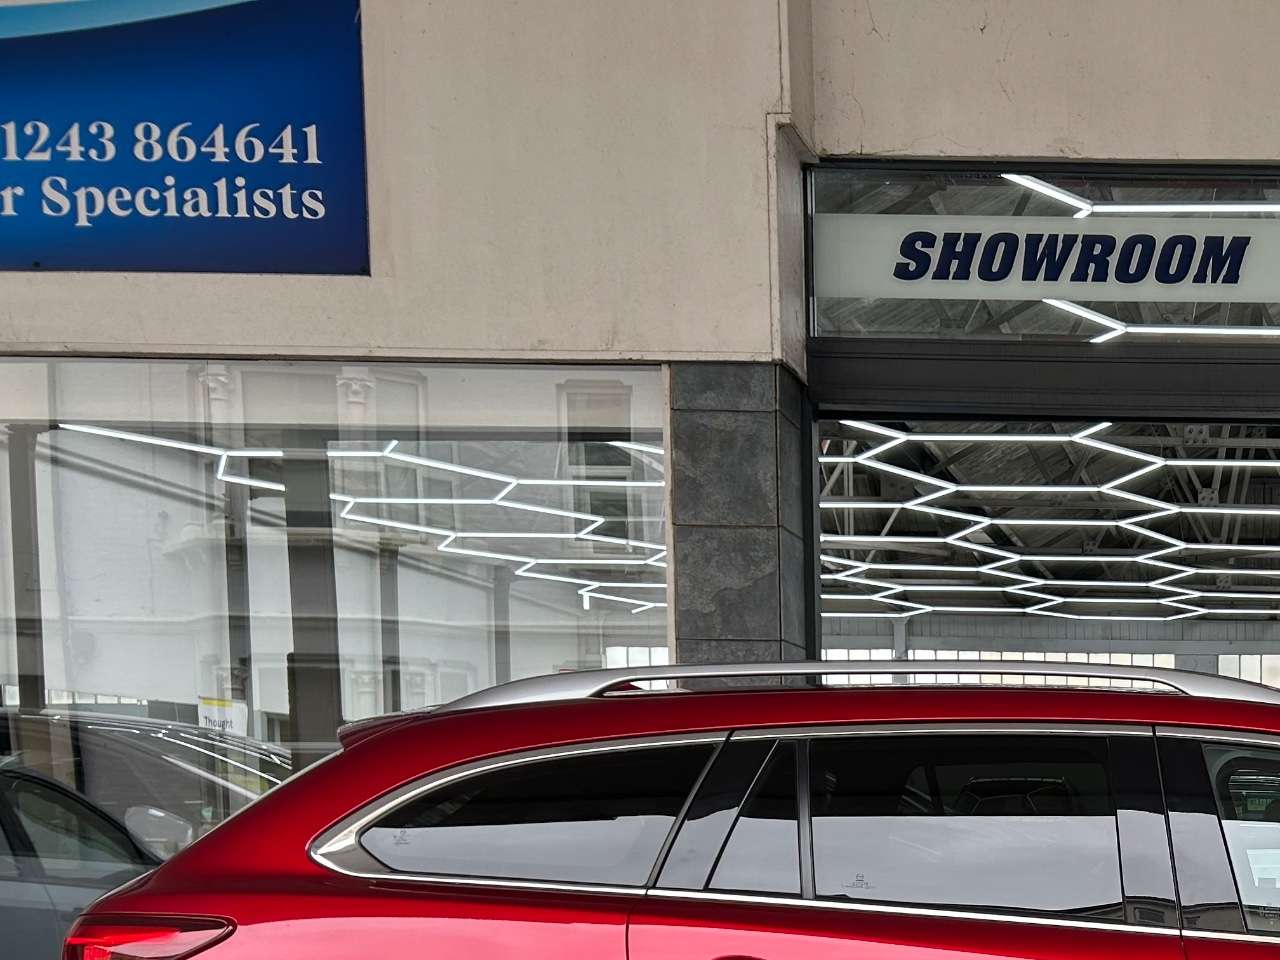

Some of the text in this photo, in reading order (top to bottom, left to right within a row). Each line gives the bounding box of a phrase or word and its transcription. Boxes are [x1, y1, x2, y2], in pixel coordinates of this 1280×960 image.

[133, 120, 323, 165] 864641
[41, 175, 327, 228] Specialists
[892, 231, 1251, 284] SHOWROOM
